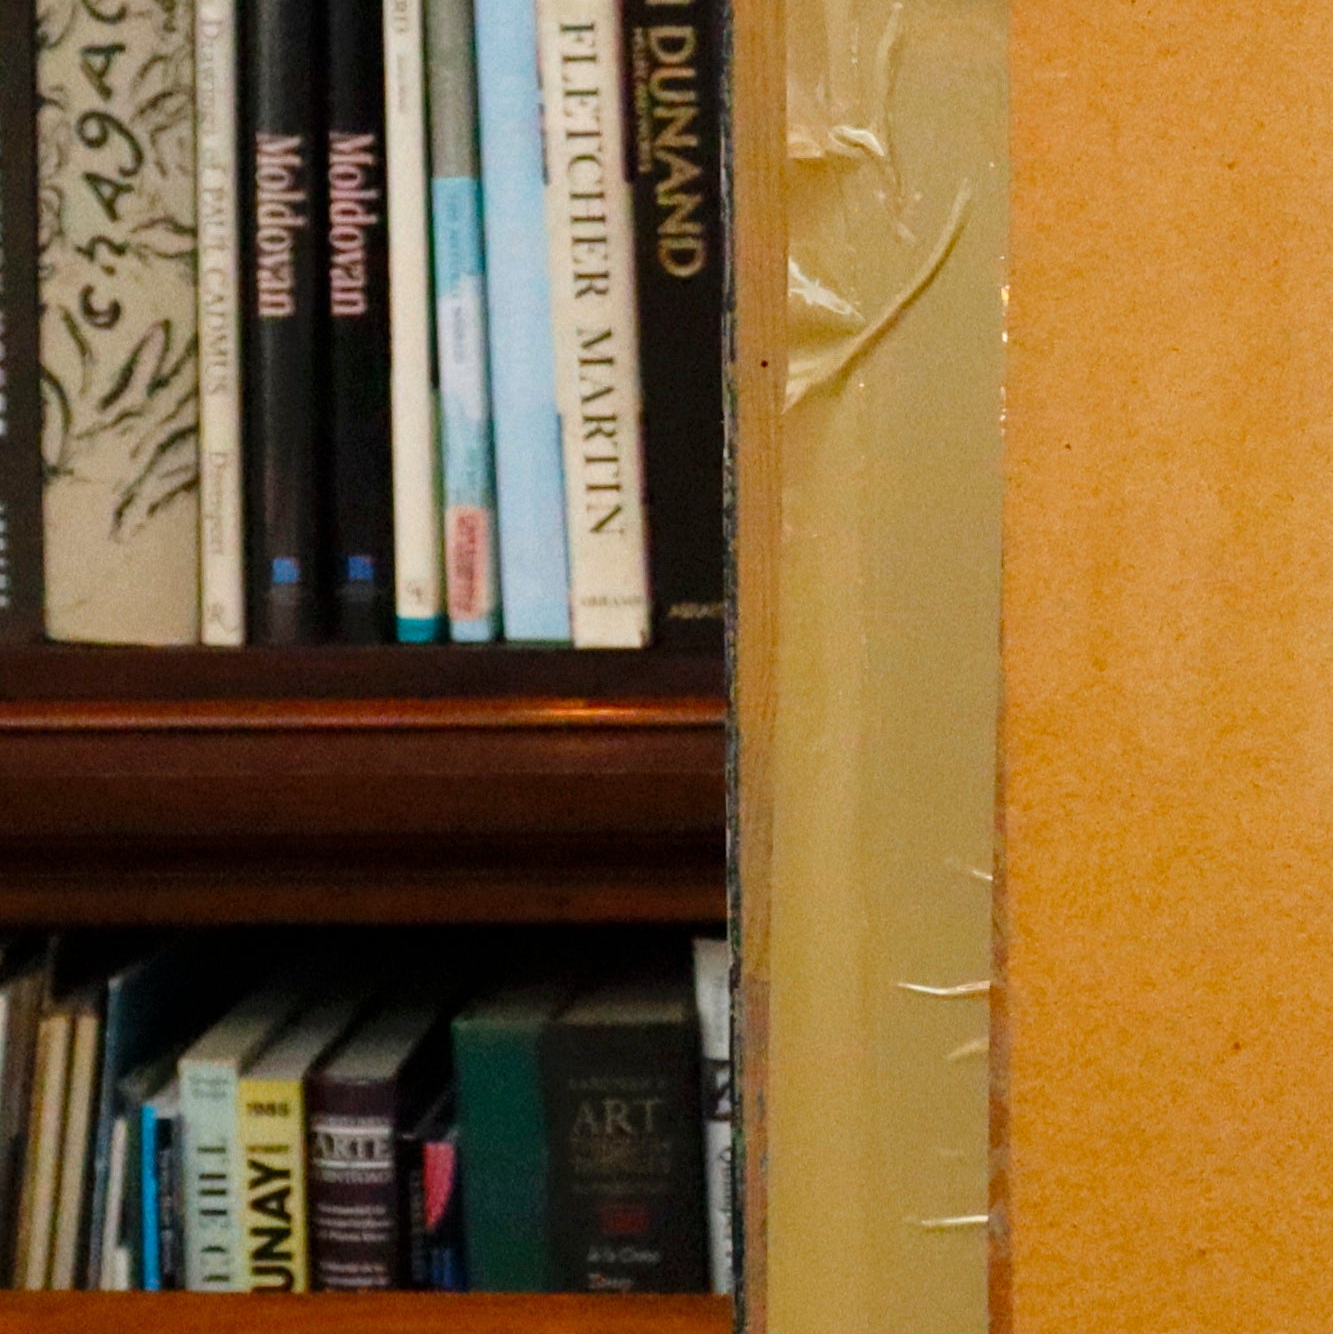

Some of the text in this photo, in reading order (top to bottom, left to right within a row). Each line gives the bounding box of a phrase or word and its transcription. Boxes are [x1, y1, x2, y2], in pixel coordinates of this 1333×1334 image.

[203, 185, 226, 252] PAUL
[255, 131, 308, 319] Moldovan
[330, 129, 379, 317] Moldovan
[559, 22, 611, 300] FLETCHER
[647, 25, 707, 279] DUNAND
[204, 265, 226, 397] CADMUS
[570, 327, 625, 538] MARTIN
[573, 1099, 666, 1135] ART
